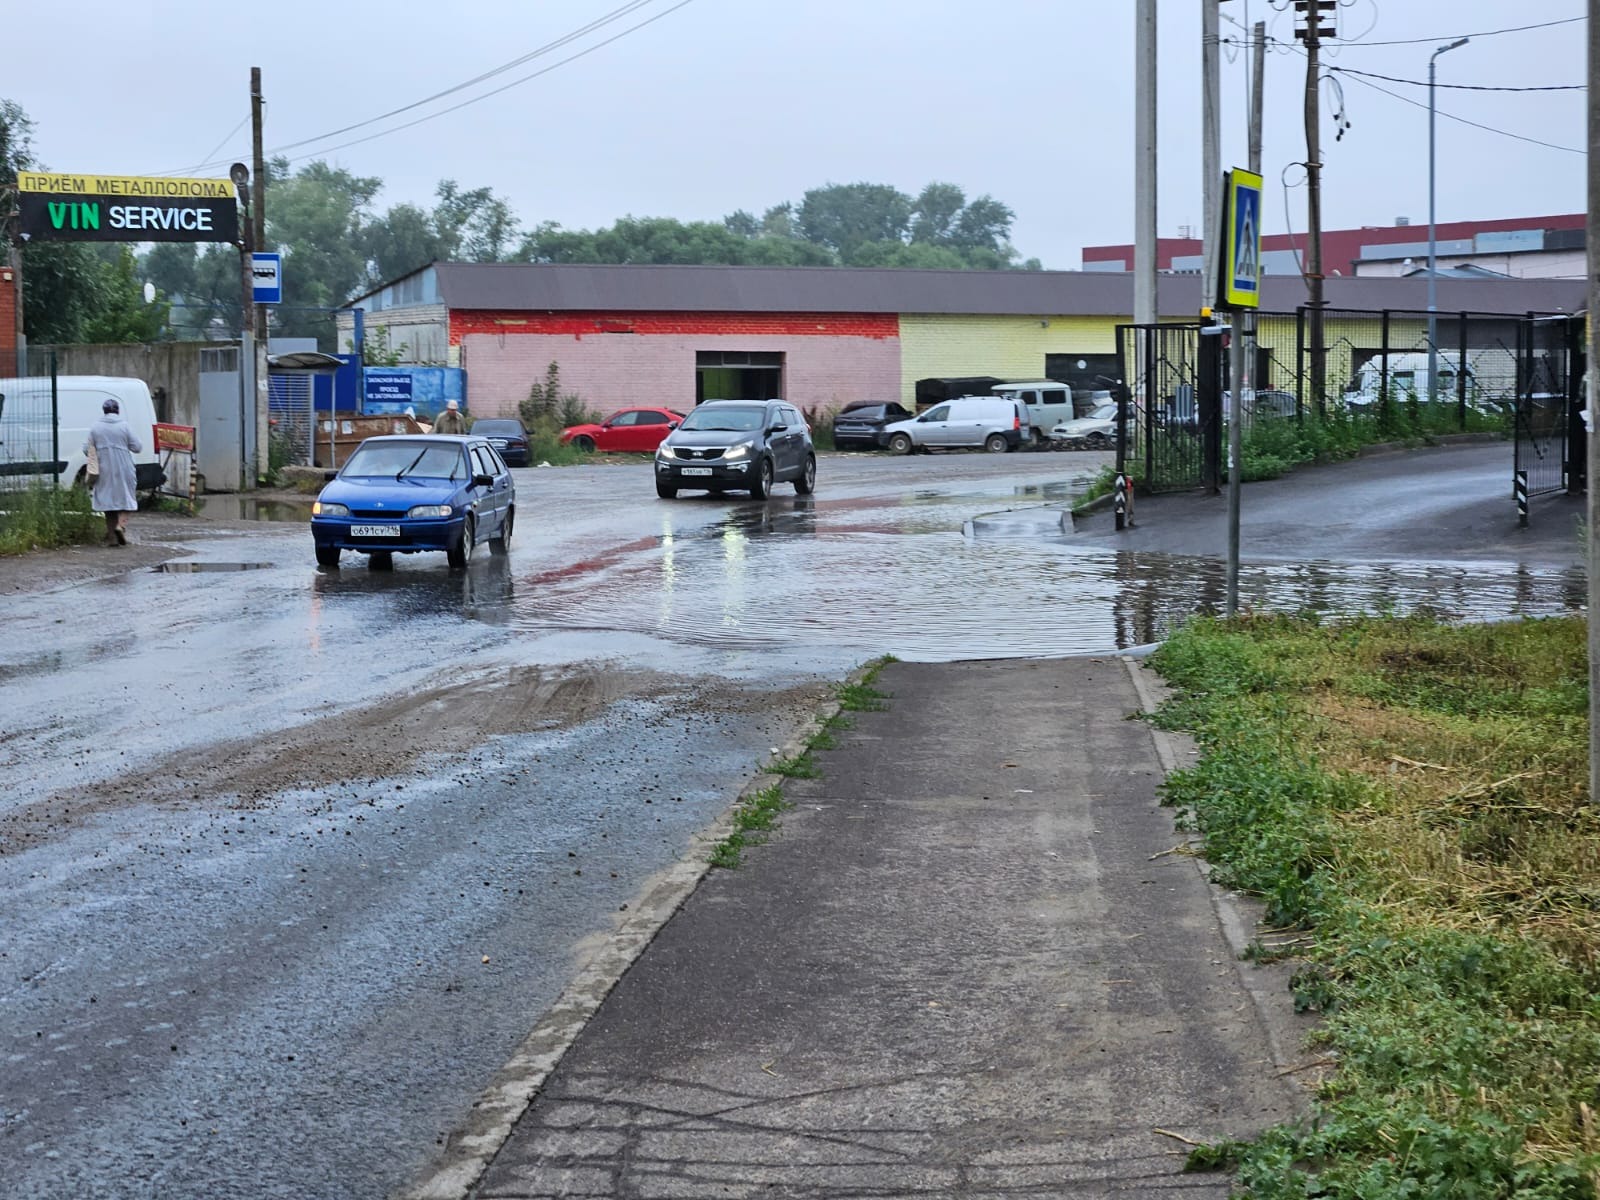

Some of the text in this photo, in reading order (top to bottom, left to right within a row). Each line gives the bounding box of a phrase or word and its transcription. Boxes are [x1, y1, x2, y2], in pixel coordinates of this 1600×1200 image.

[25, 175, 229, 197] ПРИЁМ МЕТАЛЛОЛОМА
[48, 201, 213, 231] VIN SERVICE
